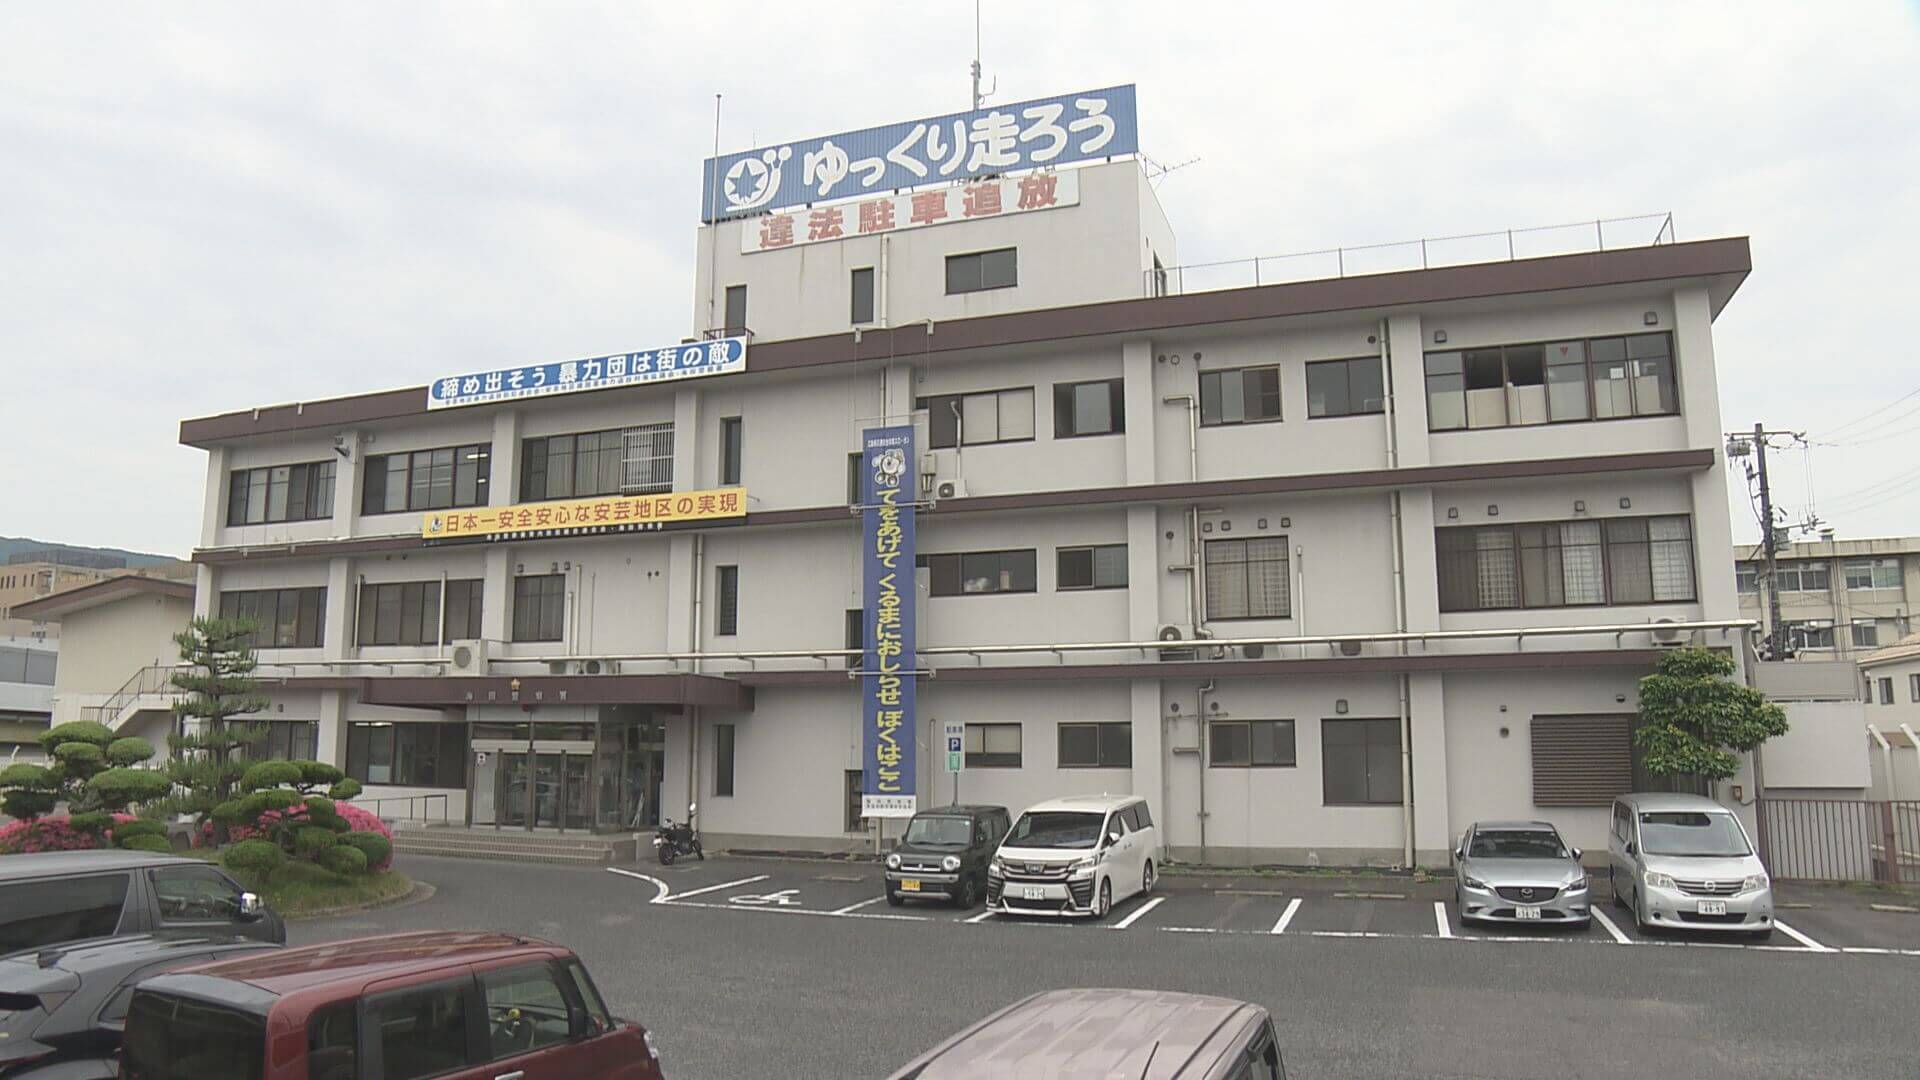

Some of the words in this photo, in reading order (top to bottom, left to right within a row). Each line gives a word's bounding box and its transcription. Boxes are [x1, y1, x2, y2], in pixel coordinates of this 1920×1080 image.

[804, 98, 1116, 196] ゆっくり走ろう
[759, 174, 1058, 249] 違法駐車追放
[441, 367, 545, 398] 締め出そう
[559, 342, 730, 384] 暴力団は街の敵
[446, 493, 737, 532] 日本一安全安心な安芸地区の実現
[877, 710, 903, 792] ぼくはここ
